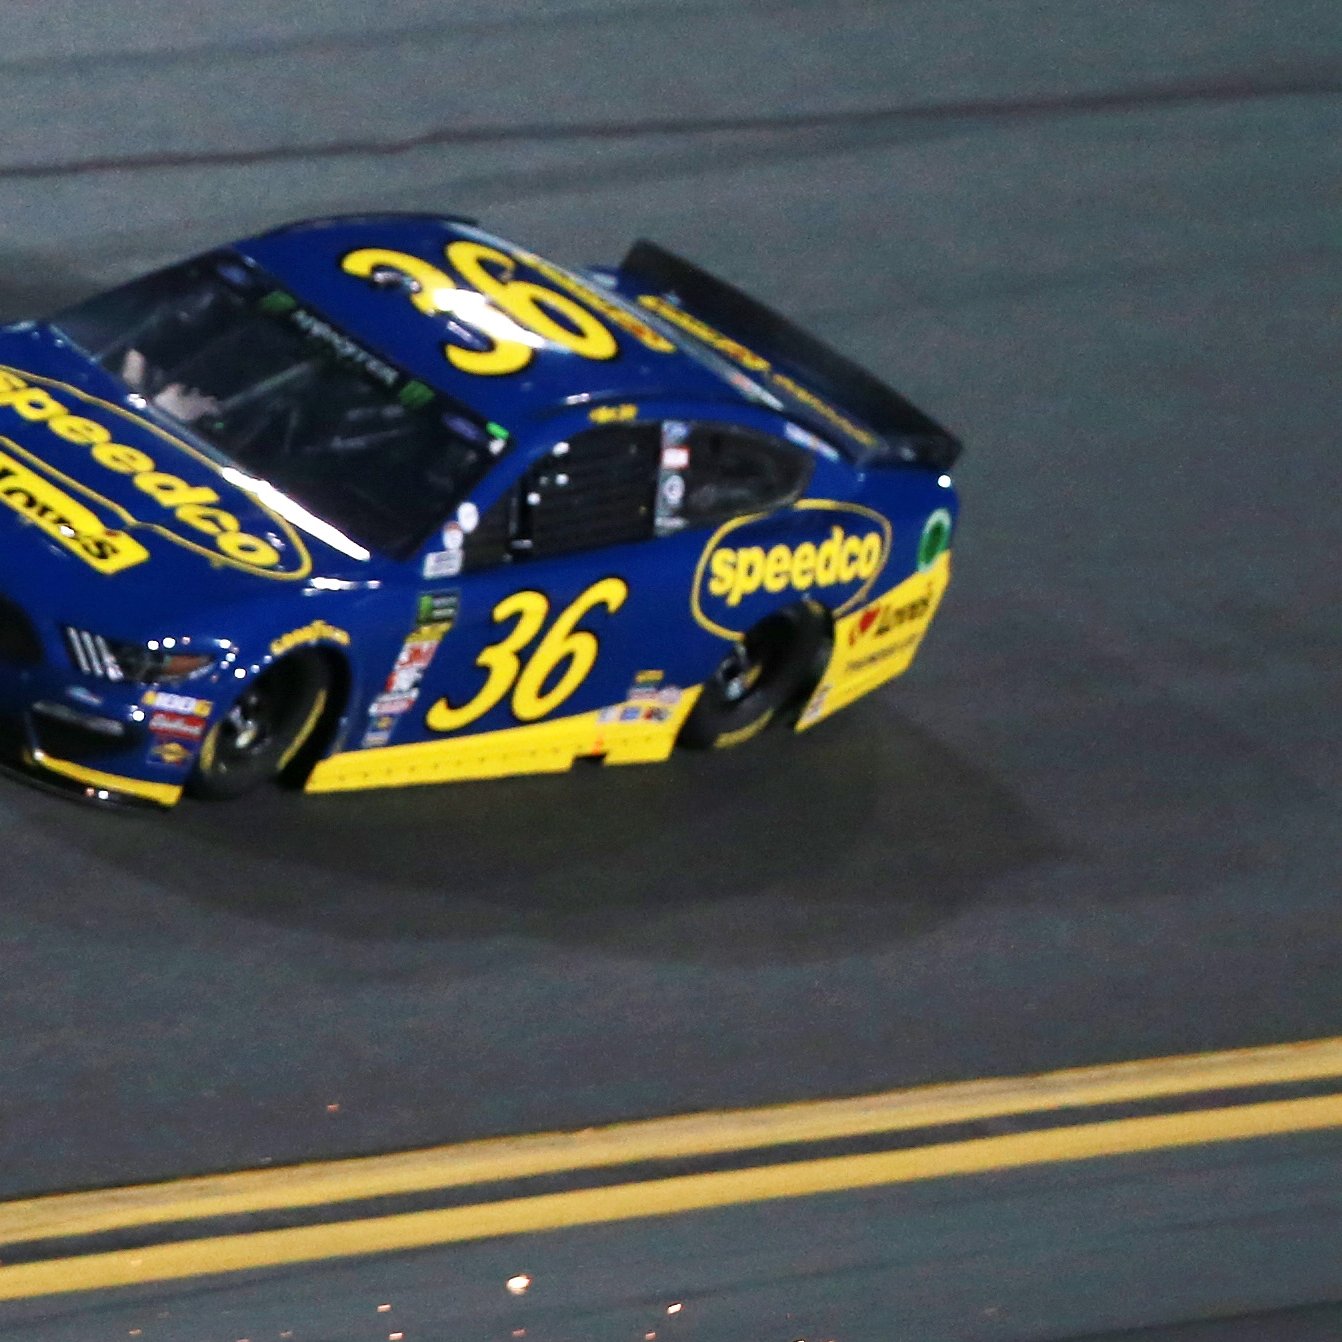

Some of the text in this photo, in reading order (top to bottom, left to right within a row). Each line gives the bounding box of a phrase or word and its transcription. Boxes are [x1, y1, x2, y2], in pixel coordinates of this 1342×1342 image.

[340, 240, 618, 376] 36
[708, 524, 883, 606] speedco
[425, 577, 626, 733] 36
